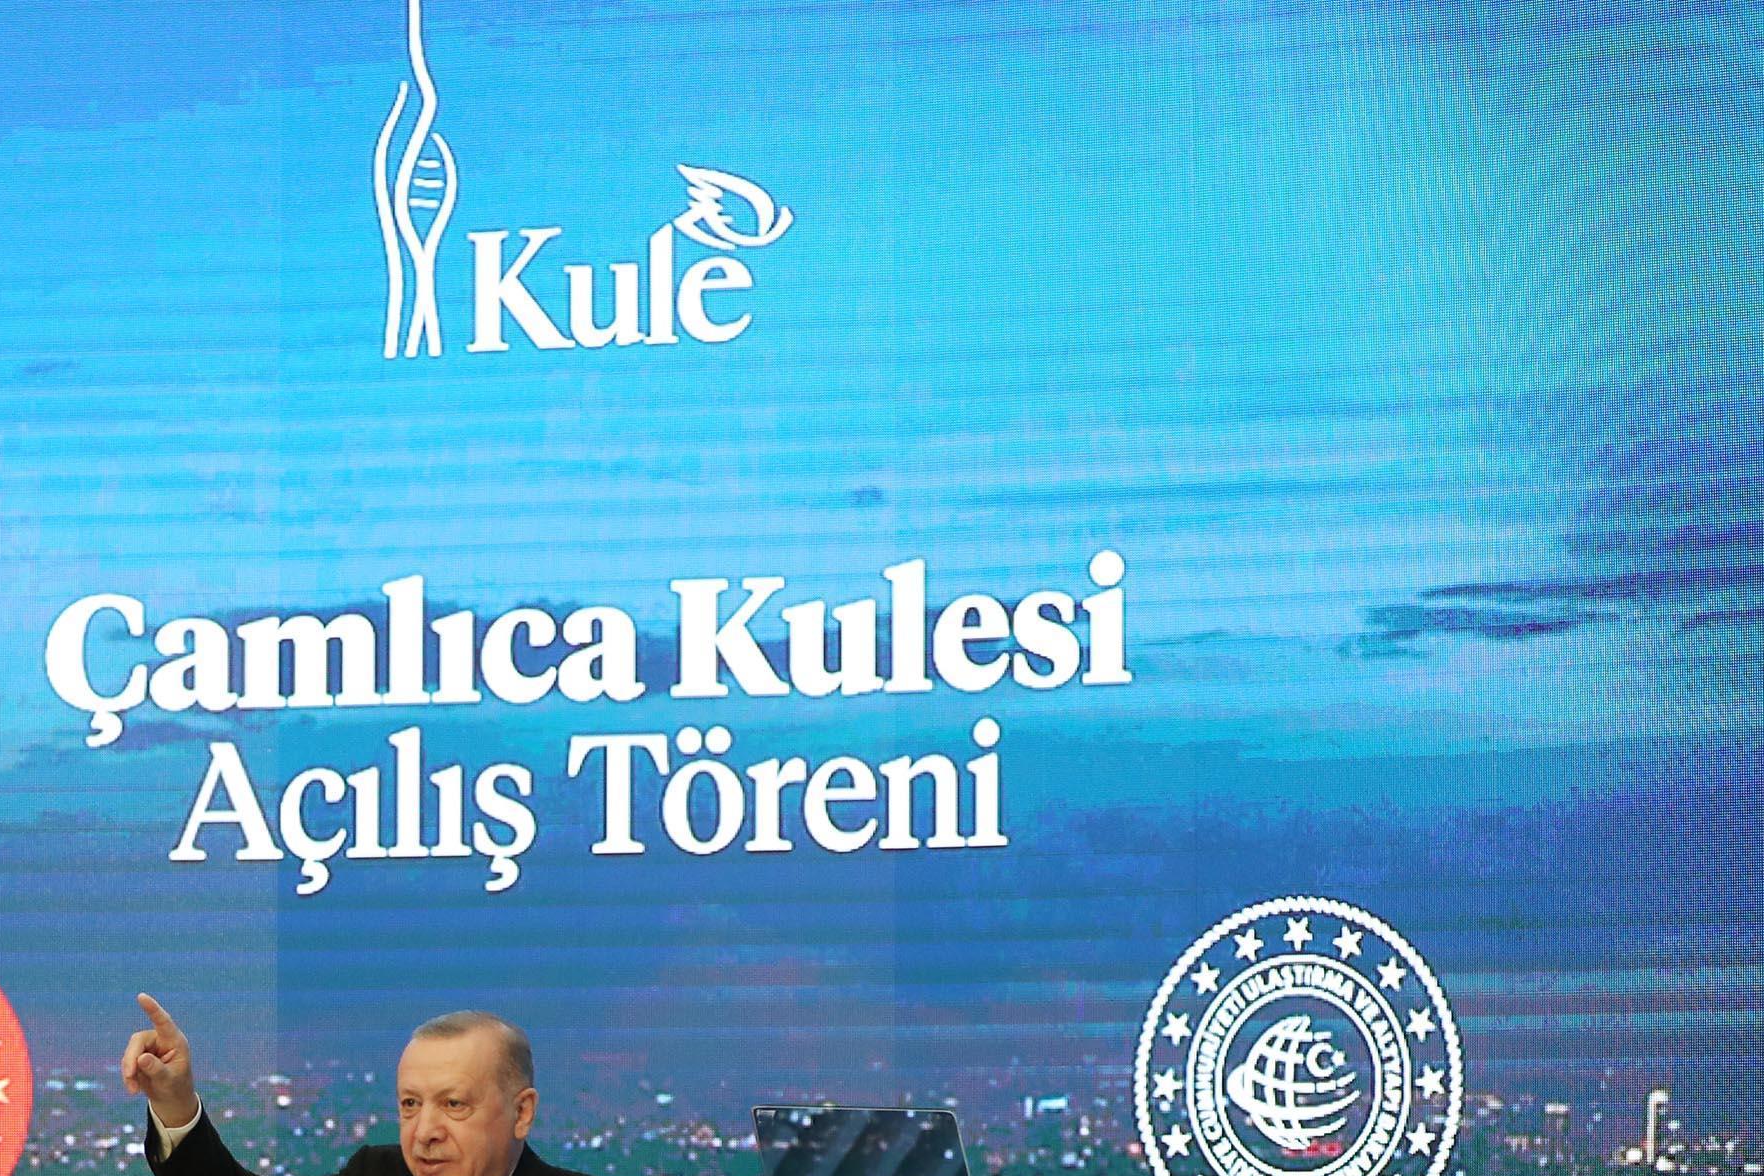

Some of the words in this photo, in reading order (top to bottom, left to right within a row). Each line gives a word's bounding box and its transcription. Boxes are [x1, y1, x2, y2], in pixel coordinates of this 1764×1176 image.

[468, 225, 752, 352] Kule
[46, 575, 645, 747] Çamlıca
[671, 551, 1132, 697] Kulesi
[169, 728, 535, 894] Açılış
[568, 719, 1007, 854] Töreni
[1354, 988, 1385, 1020] VE
